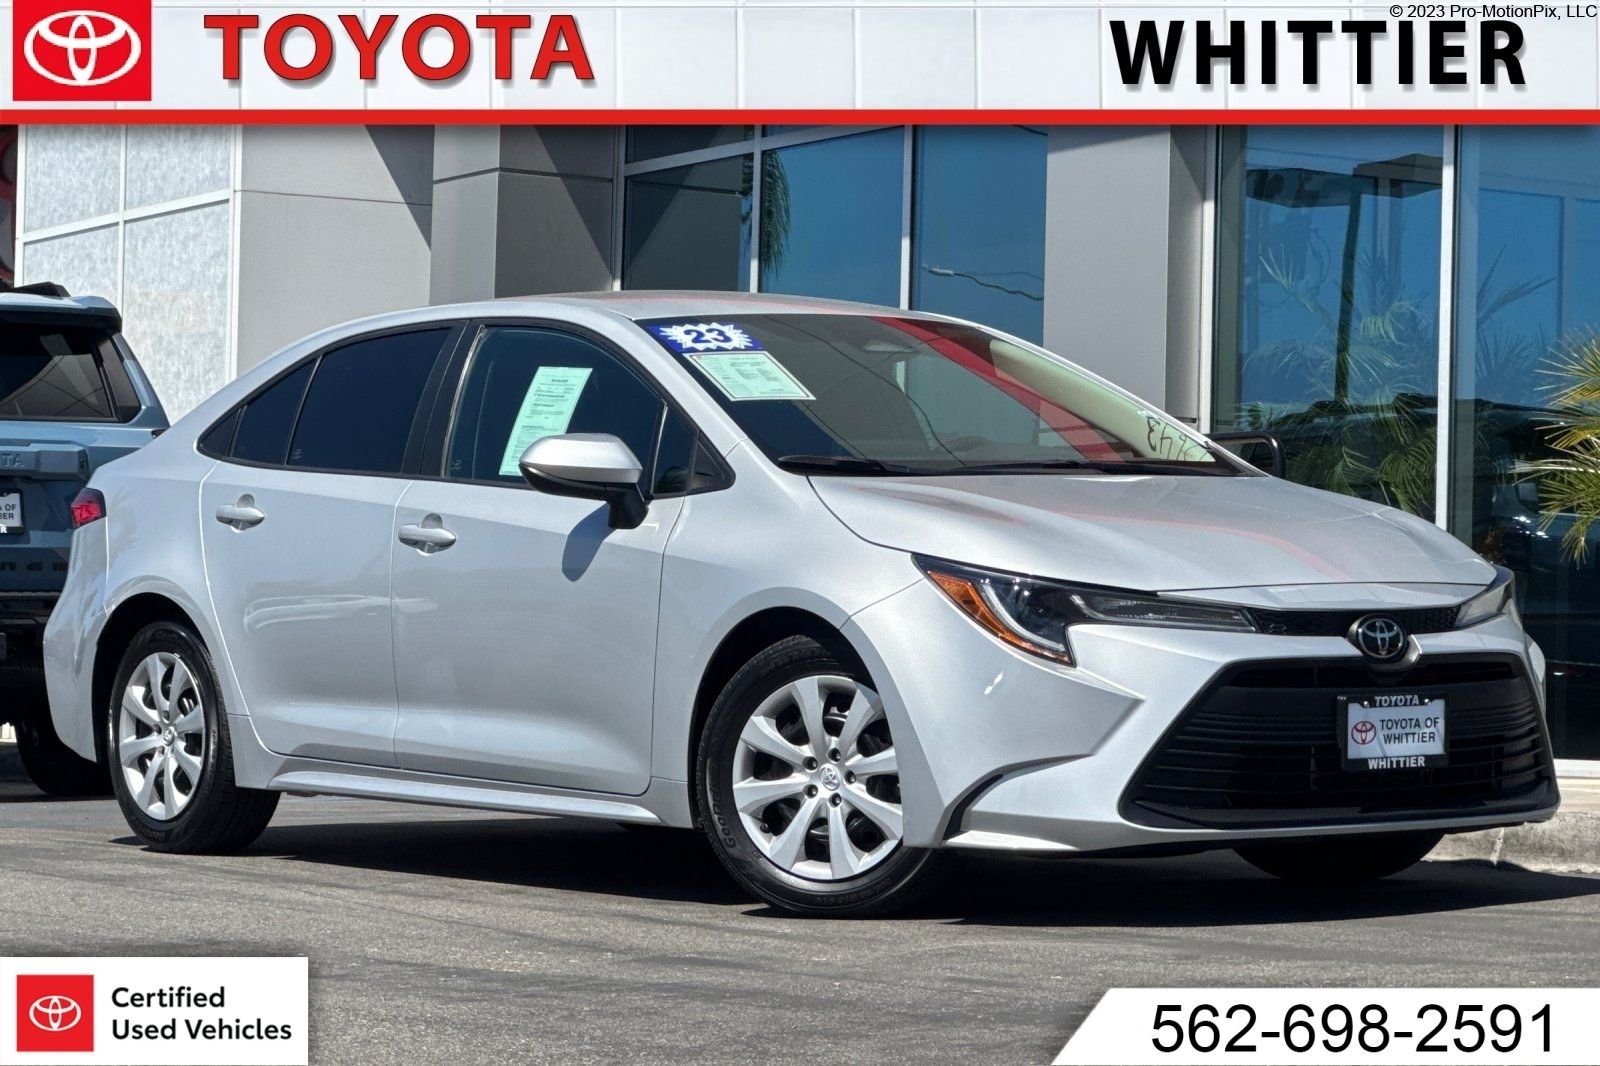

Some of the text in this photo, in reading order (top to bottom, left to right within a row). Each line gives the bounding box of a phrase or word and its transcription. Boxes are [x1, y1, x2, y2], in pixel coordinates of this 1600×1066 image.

[683, 328, 733, 344] 23
[1375, 695, 1419, 707] TOYOTA
[1380, 717, 1440, 730] TOYOTA OF
[1383, 732, 1436, 744] WHITTIER
[1368, 756, 1425, 770] WHITTIER
